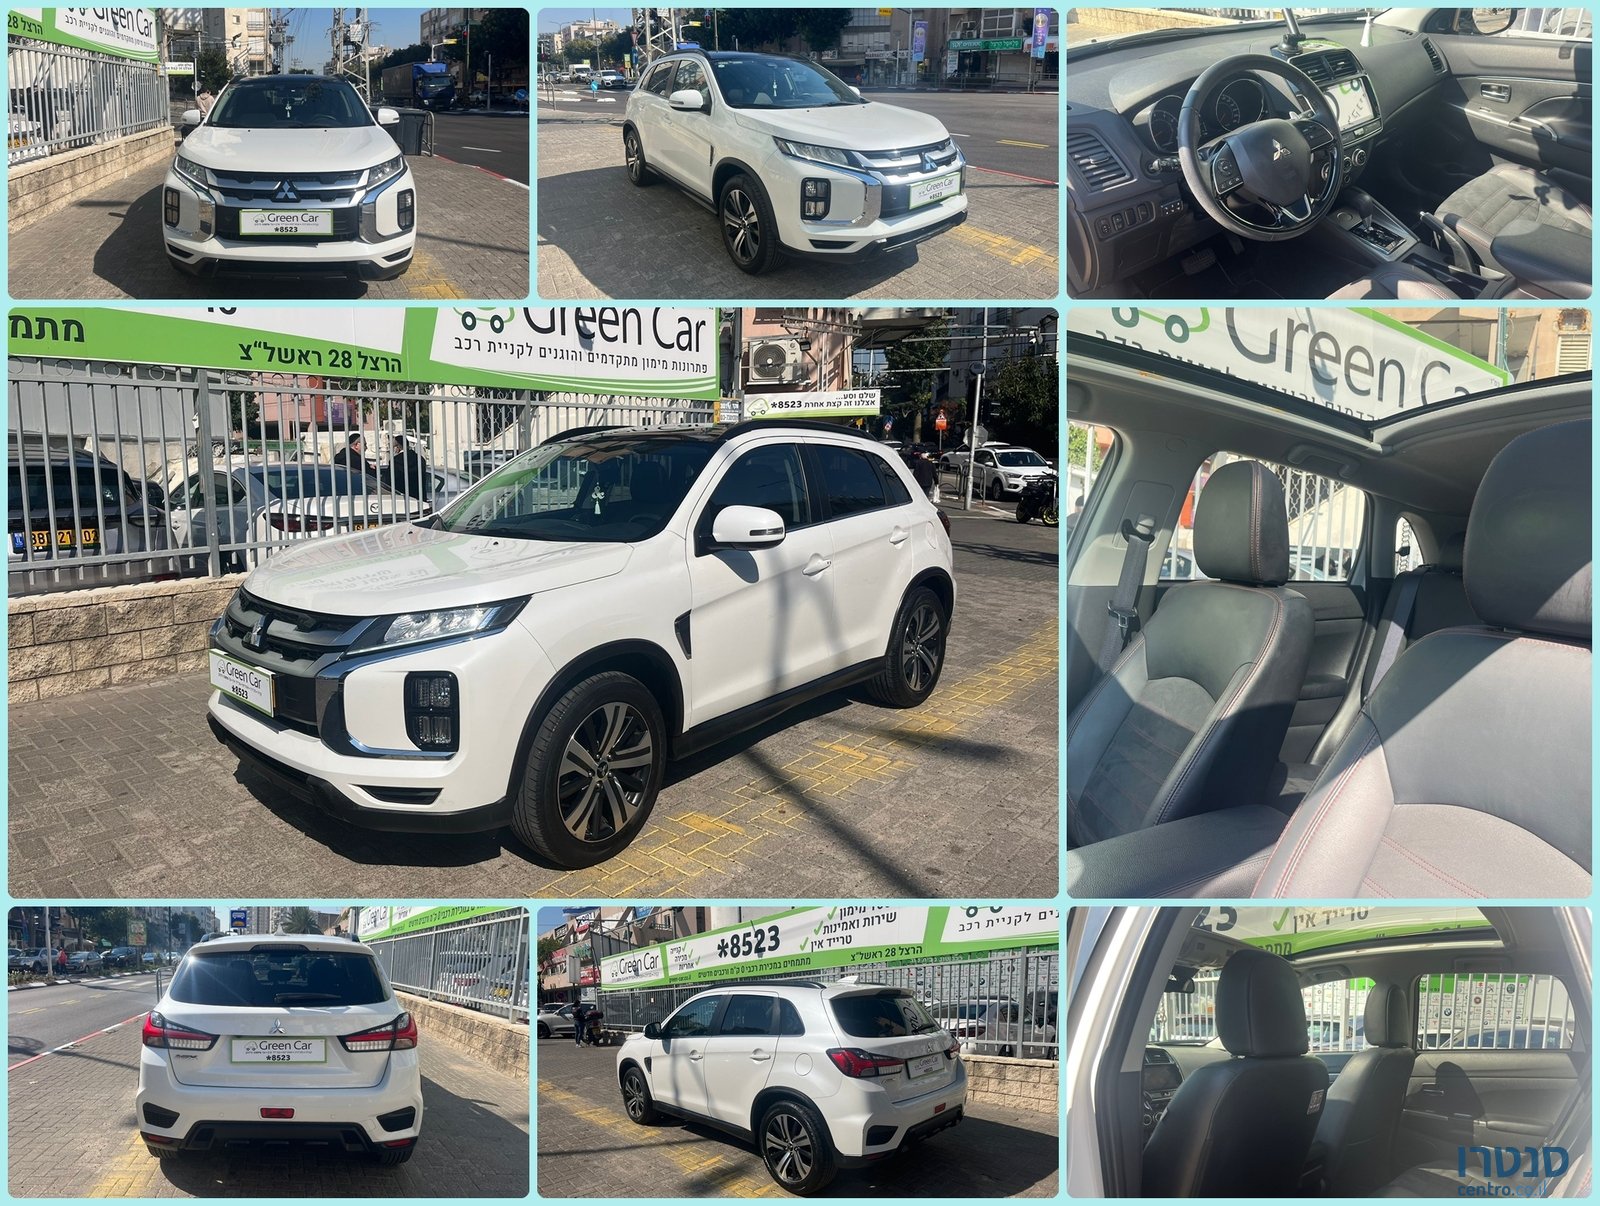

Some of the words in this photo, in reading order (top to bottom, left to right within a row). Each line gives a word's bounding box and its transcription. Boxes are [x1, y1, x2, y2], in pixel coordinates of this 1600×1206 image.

[8, 14, 19, 29] 28
[20, 17, 43, 35] הרצל
[65, 15, 77, 26] רכב
[79, 19, 98, 33] לקניית
[136, 8, 153, 38] Car
[267, 213, 299, 223] Green
[300, 213, 319, 223] Car
[523, 307, 643, 345] Green
[652, 307, 706, 352] Car
[454, 336, 481, 352] רכב
[487, 342, 533, 359] לקניית
[328, 348, 353, 369] 28
[357, 350, 403, 373] הרצל
[539, 346, 583, 362] והוגנים
[587, 350, 639, 368] מתקדמים
[1227, 307, 1405, 408] Green
[642, 357, 668, 371] מימון
[671, 360, 708, 374] פתרונות
[226, 661, 248, 684] Green
[248, 671, 262, 689] Car
[822, 919, 860, 935] ואמינות
[862, 911, 897, 928] שירות
[958, 921, 980, 932] רכב
[985, 911, 1032, 928] לקניית
[811, 939, 824, 953] אין
[826, 934, 853, 947] טרייד
[885, 947, 897, 958] 28
[898, 944, 923, 955] הרצל
[619, 958, 642, 975] Green
[643, 952, 659, 971] Car
[745, 964, 758, 973] רכבי
[758, 961, 782, 971] במכירת
[783, 957, 811, 967] מתמחים
[259, 1040, 292, 1051] Green
[294, 1040, 312, 1050] Car
